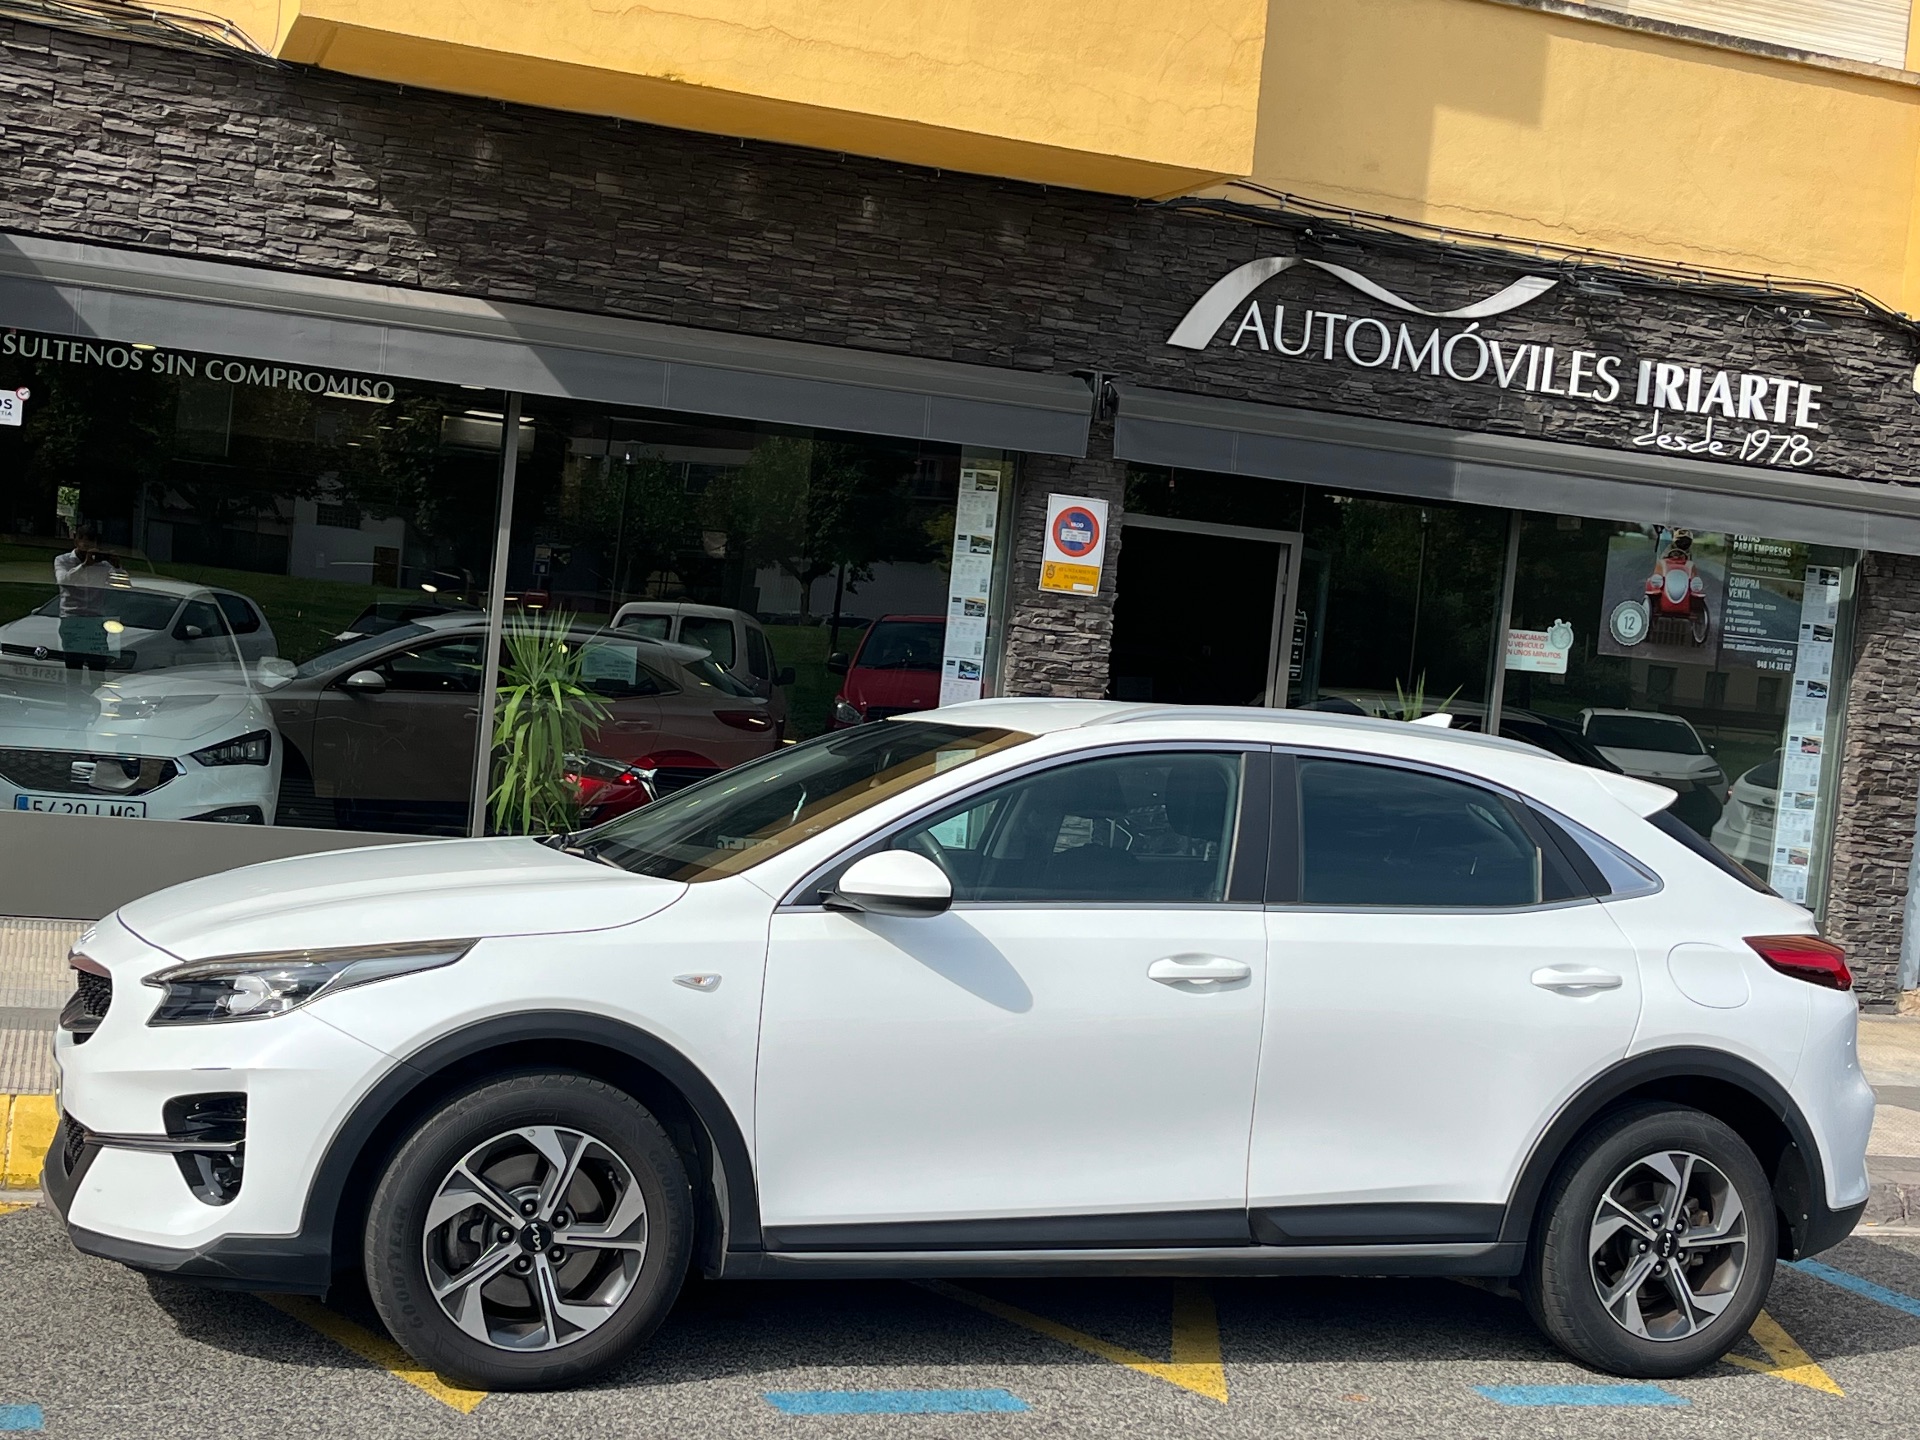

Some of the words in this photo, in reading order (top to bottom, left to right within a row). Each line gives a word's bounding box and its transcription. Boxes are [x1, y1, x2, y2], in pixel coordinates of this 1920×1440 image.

[0, 333, 143, 371] SULTENOS
[152, 353, 196, 377] SIN
[205, 360, 395, 400] COMPROMISO
[1230, 300, 1622, 403] AUTOMÓVILES
[1636, 360, 1823, 429] IRIARTE
[0, 398, 12, 410] S
[1633, 409, 1727, 456] desde
[1740, 429, 1814, 466] 1978
[1733, 541, 1752, 552] PARA
[1754, 543, 1792, 557] EMPRESAS
[1730, 577, 1760, 589] COMPRA
[1728, 588, 1750, 600] VENTA
[1624, 616, 1635, 630] 12
